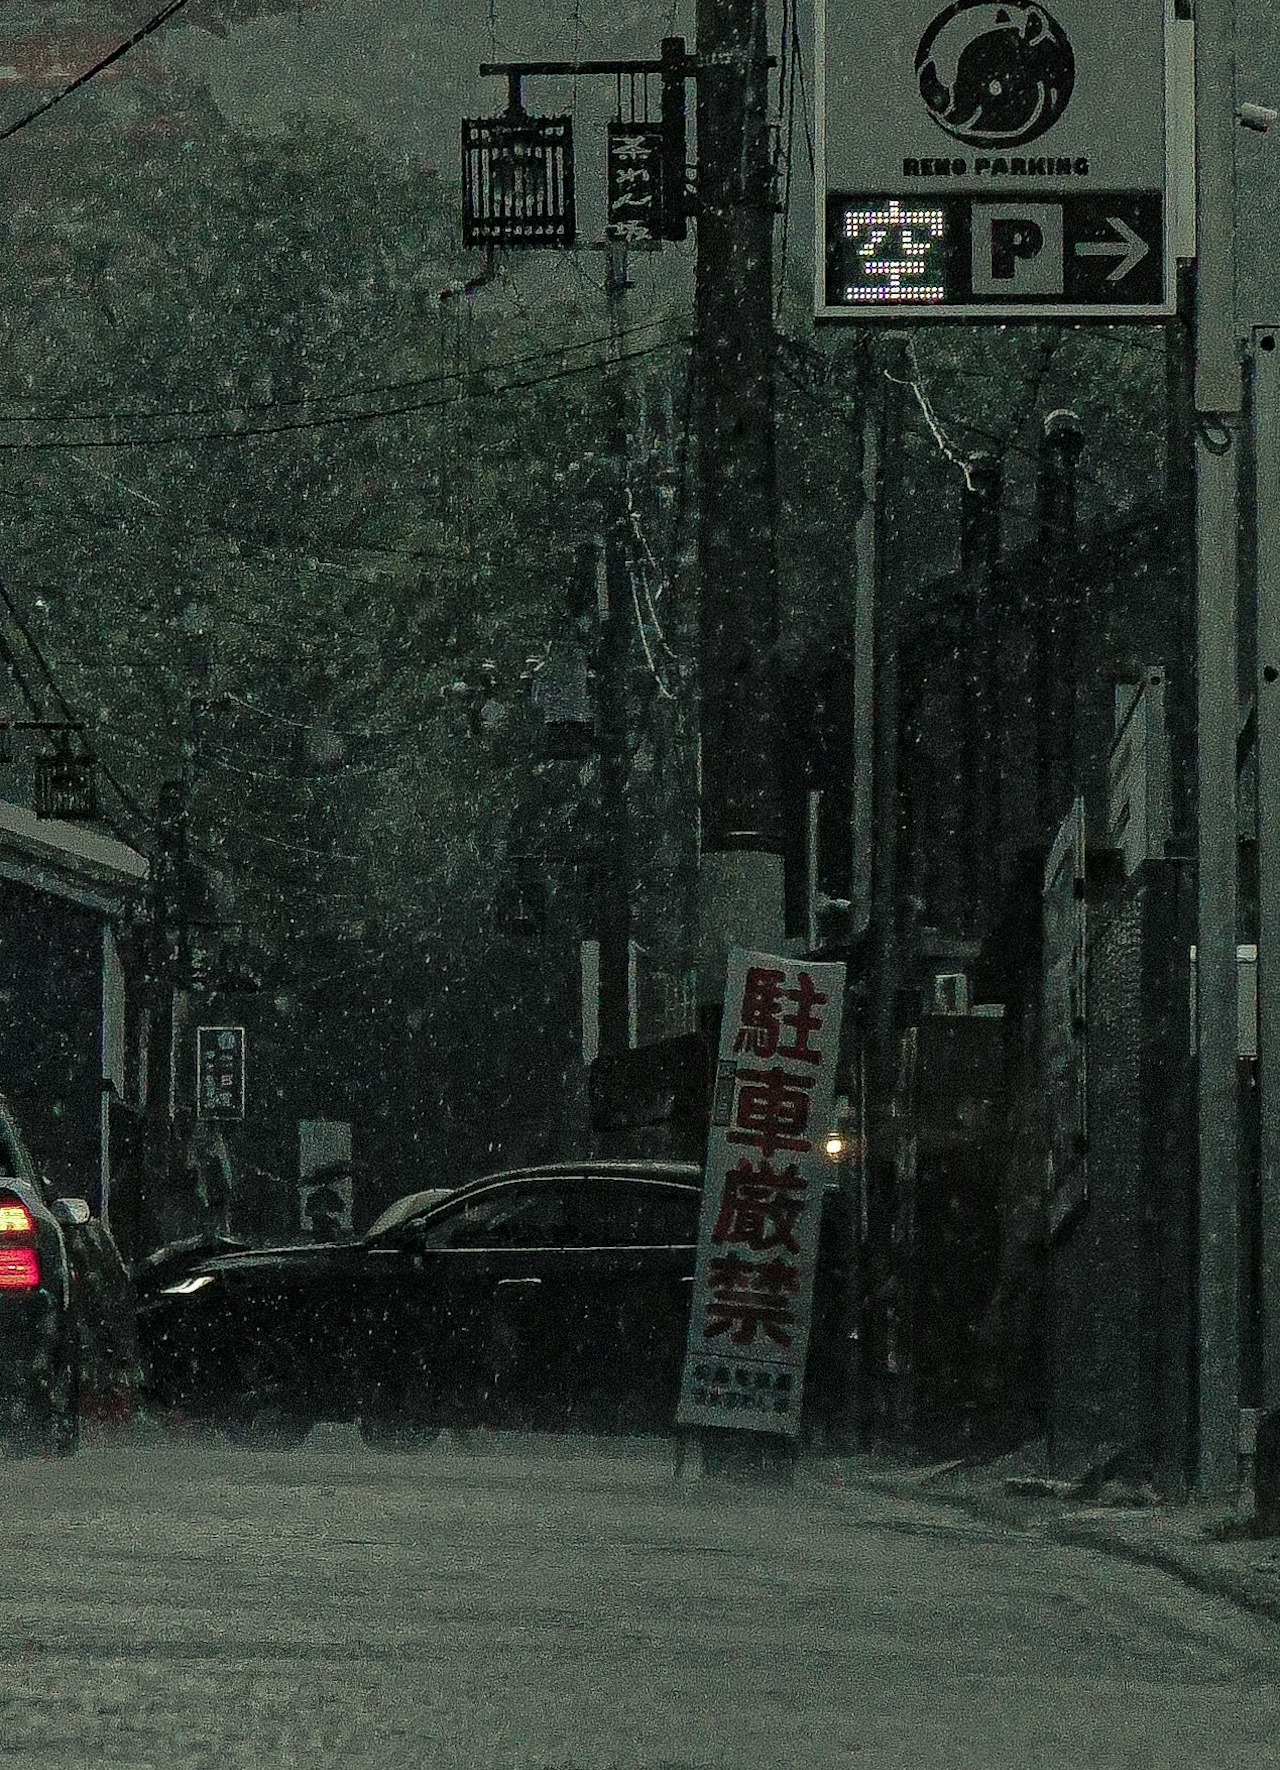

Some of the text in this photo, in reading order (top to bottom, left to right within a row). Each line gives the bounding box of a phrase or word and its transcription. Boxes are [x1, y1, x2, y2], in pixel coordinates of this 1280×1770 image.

[975, 156, 1089, 176] PARKING
[845, 199, 1044, 301] 空 P
[704, 966, 827, 1347] 駐車厳禁
